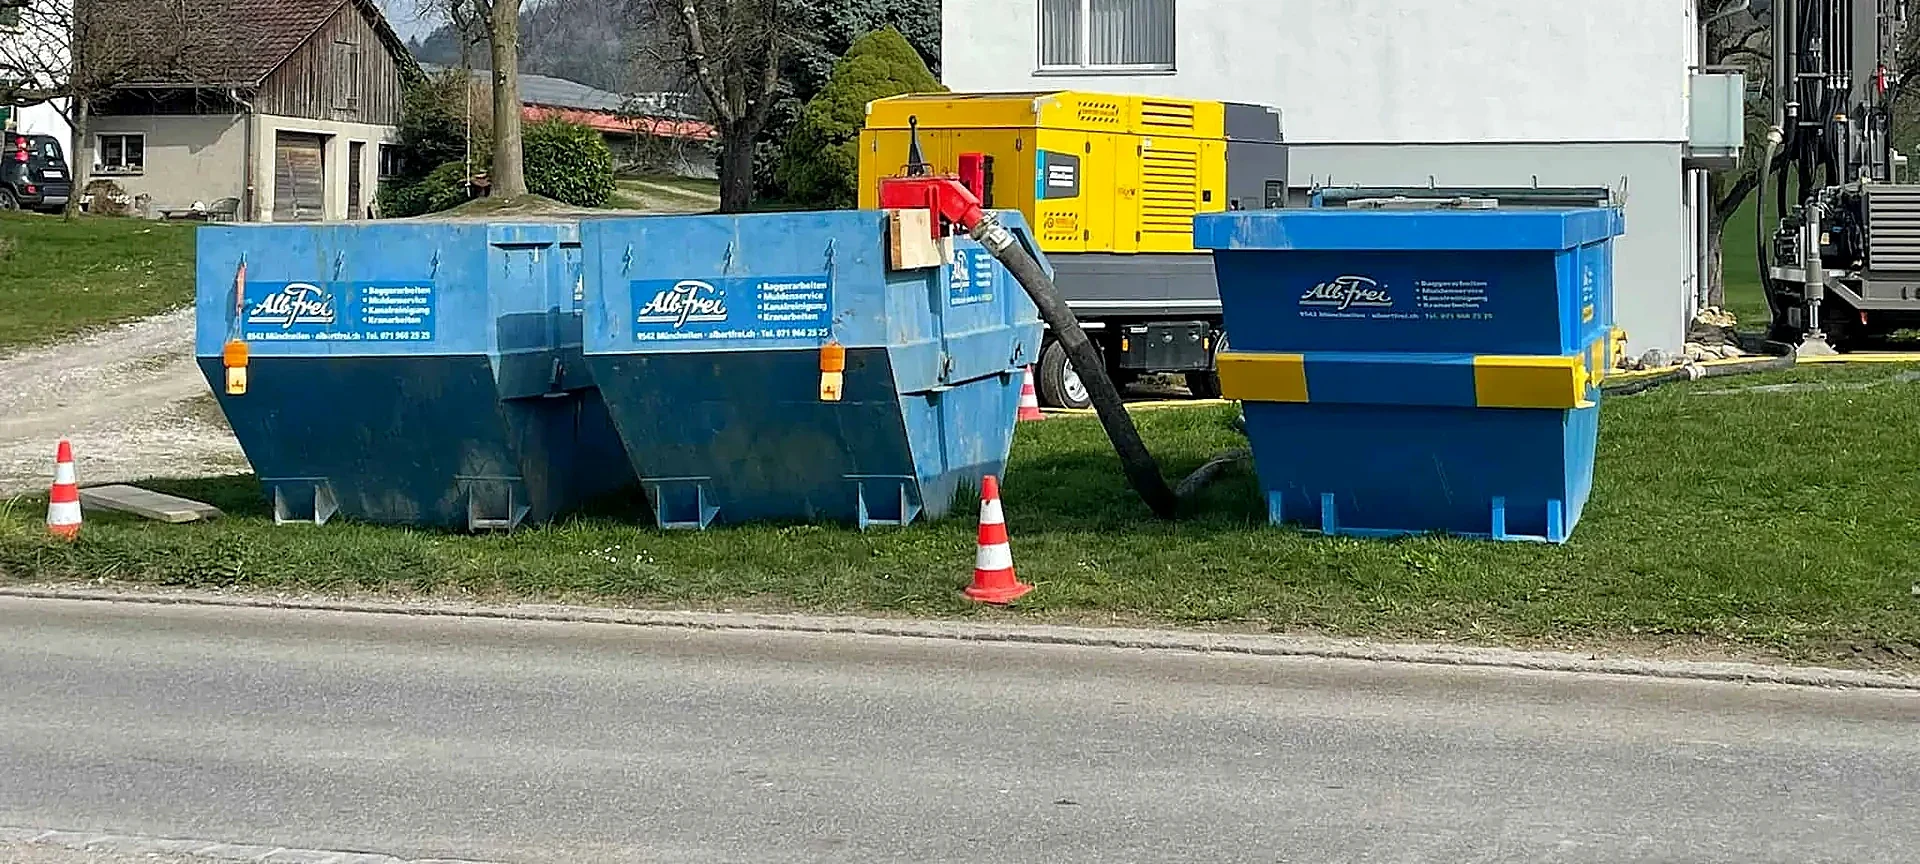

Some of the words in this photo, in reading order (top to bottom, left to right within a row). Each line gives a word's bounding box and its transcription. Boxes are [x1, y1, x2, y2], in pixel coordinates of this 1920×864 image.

[368, 286, 431, 296] Baggerarbeiten
[763, 281, 827, 292] Baggerarbeiten
[368, 296, 427, 304] Muldenservice
[763, 291, 824, 300] Muldenservice
[367, 306, 431, 316] Kanalreinigung
[763, 302, 827, 311] Kanalreinigung
[367, 315, 421, 324] Kranarbeiten
[763, 311, 818, 321] Kranarbeiten
[380, 331, 393, 340] 071
[760, 329, 775, 338] Tel.
[776, 329, 790, 338] 071
